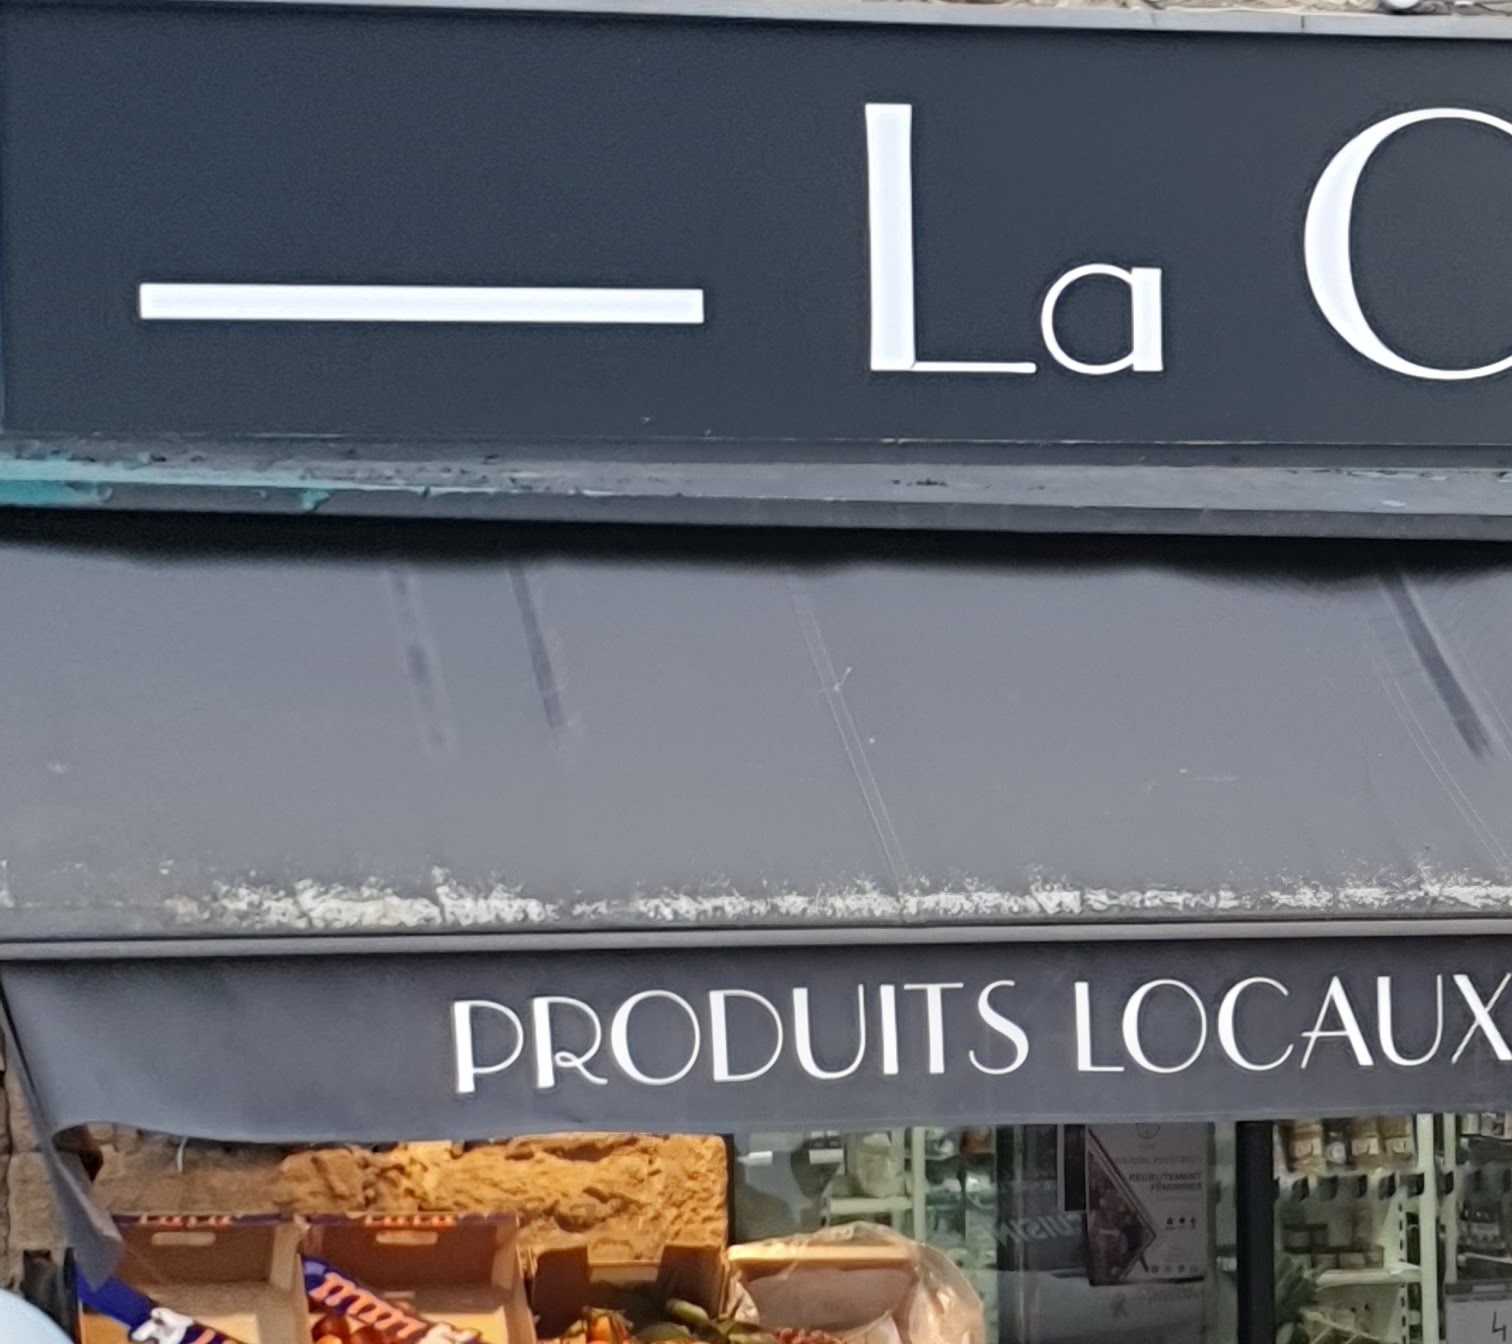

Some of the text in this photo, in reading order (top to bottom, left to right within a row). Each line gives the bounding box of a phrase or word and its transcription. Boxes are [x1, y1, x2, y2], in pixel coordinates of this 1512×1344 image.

[866, 102, 1163, 373] La
[453, 979, 1030, 1094] PRODUITS
[1491, 1311, 1507, 1342] 4
